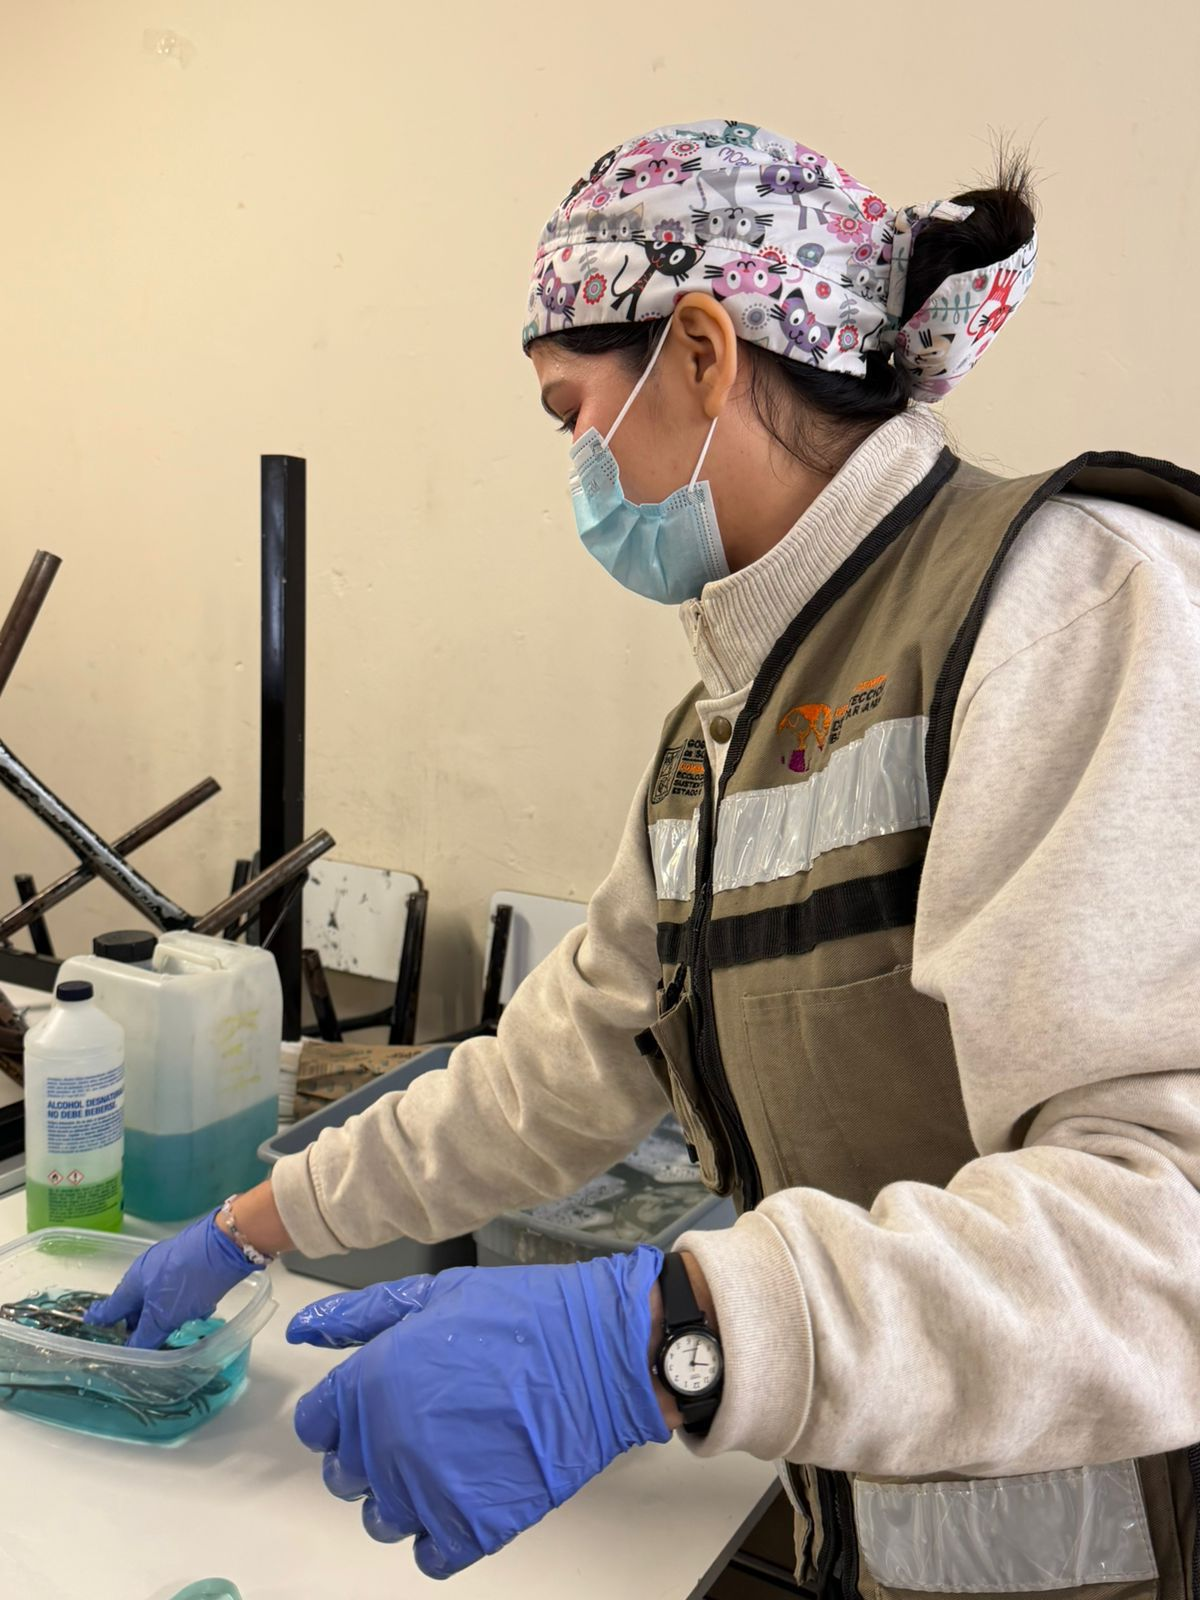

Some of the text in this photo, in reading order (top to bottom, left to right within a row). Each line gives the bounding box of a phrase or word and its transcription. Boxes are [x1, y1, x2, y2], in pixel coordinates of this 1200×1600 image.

[47, 1100, 84, 1110] ALCOHOL
[47, 1110, 59, 1119] NO
[60, 1110, 82, 1120] DEBE
